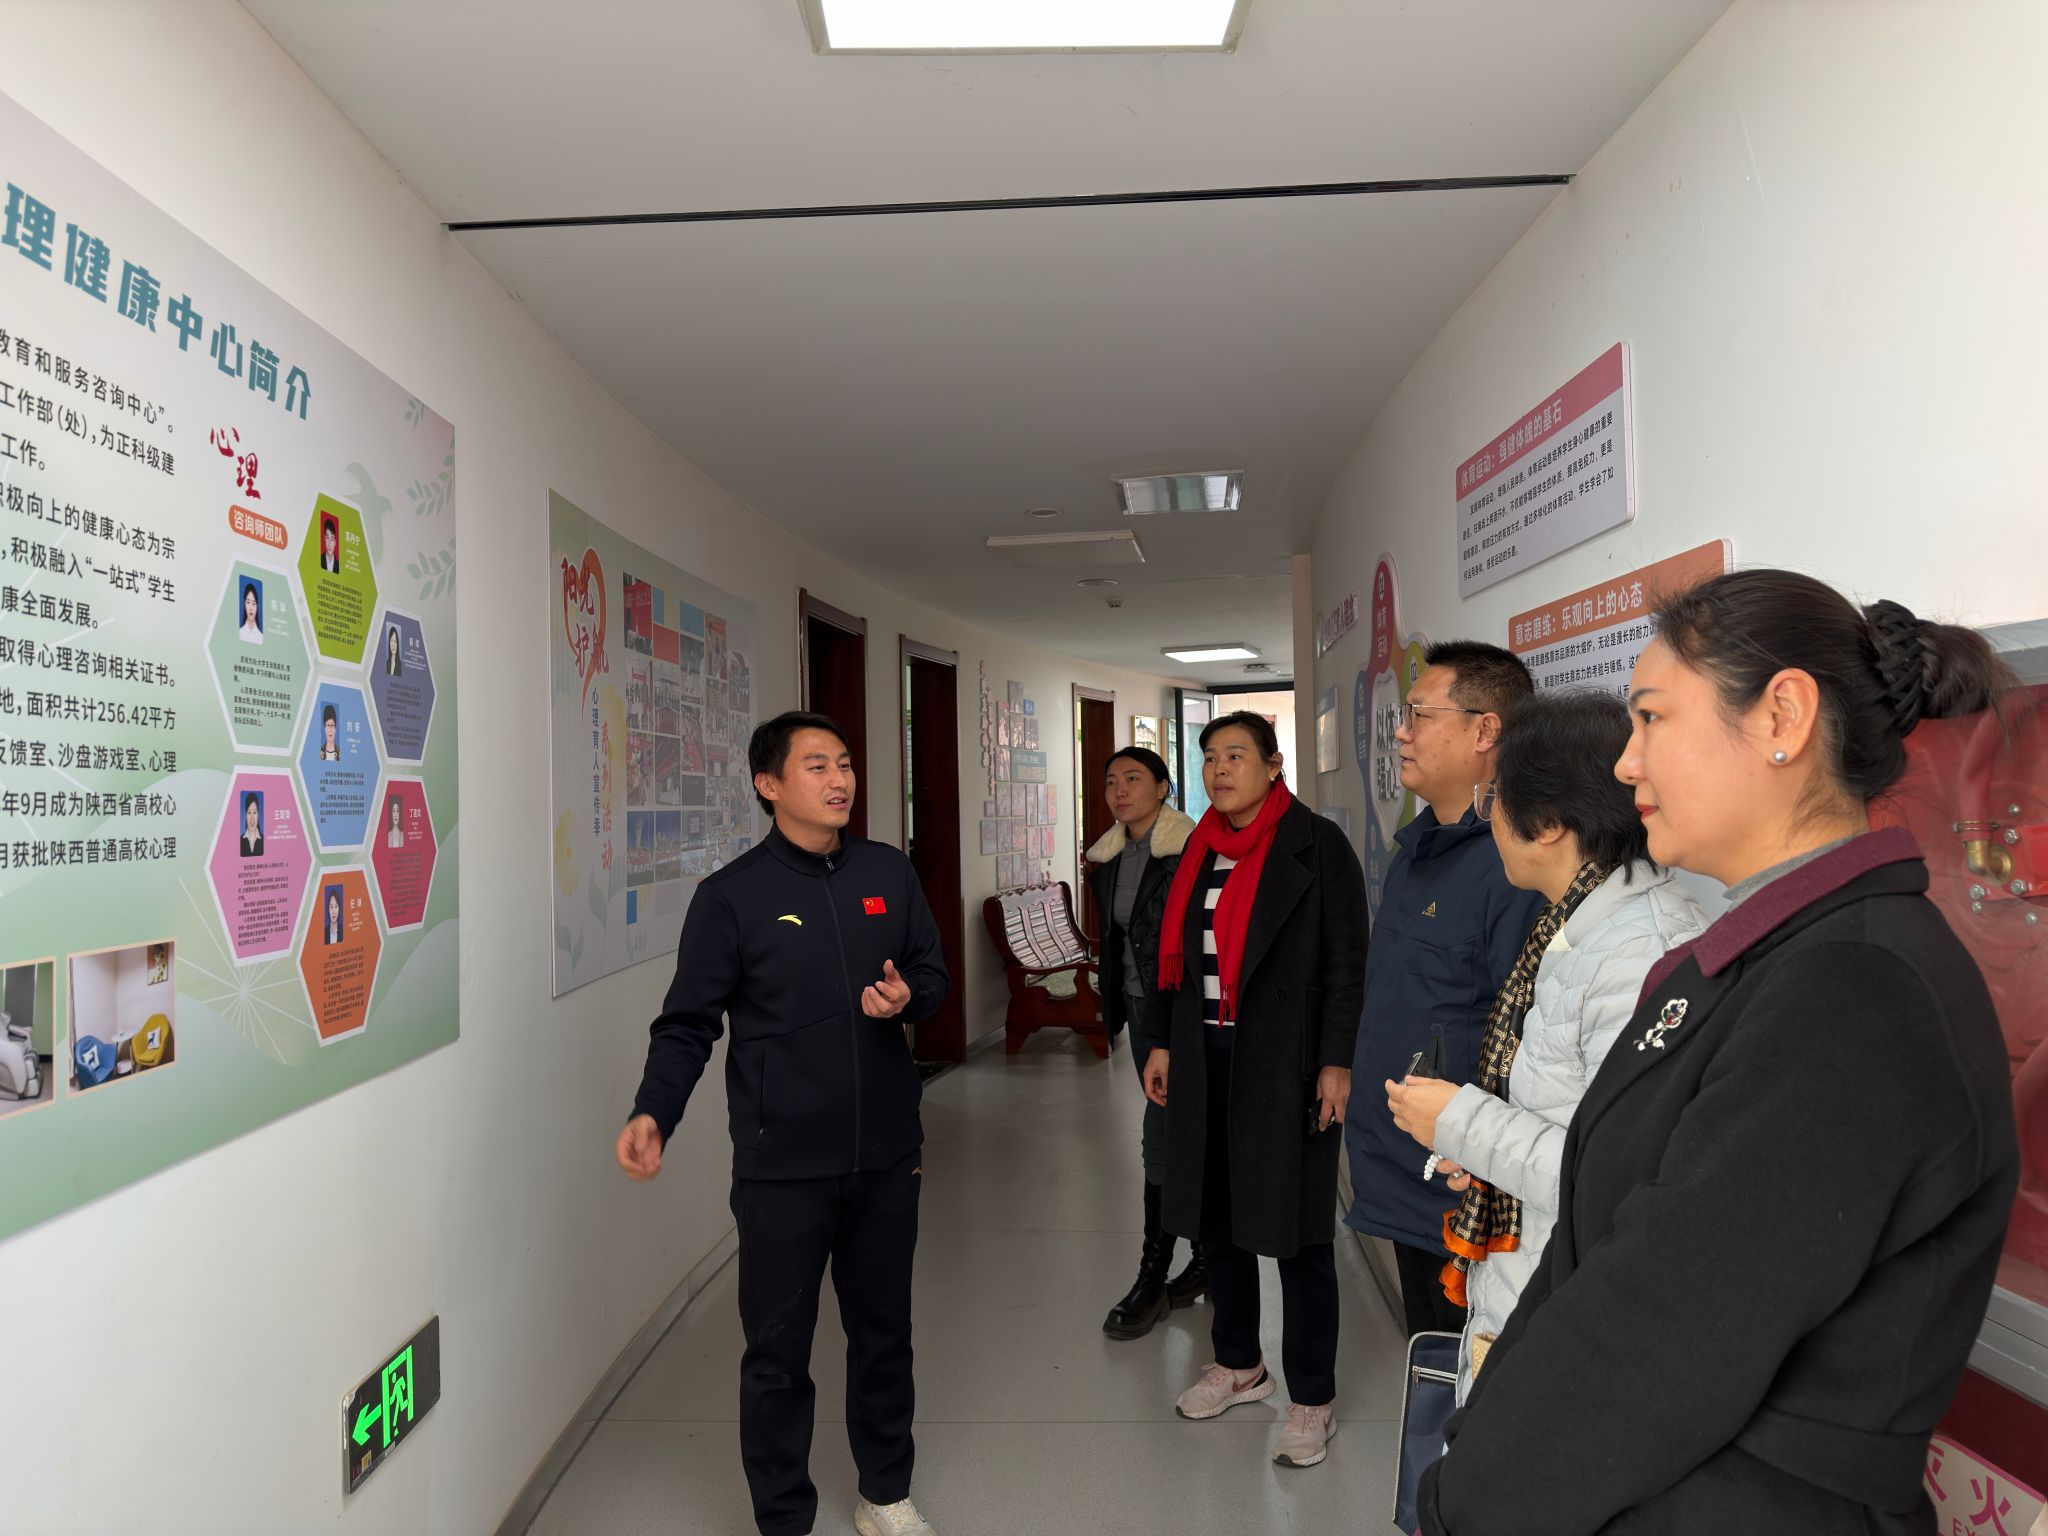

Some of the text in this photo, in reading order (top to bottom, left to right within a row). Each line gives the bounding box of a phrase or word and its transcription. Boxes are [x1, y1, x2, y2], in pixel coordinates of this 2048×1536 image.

[1, 182, 312, 420] 理健康中心简介
[1, 433, 45, 471] 工作。
[0, 481, 175, 559] 极向上的健康心态为宗
[234, 509, 284, 545] 咨询师团队
[1, 585, 98, 629] 康全面发展。
